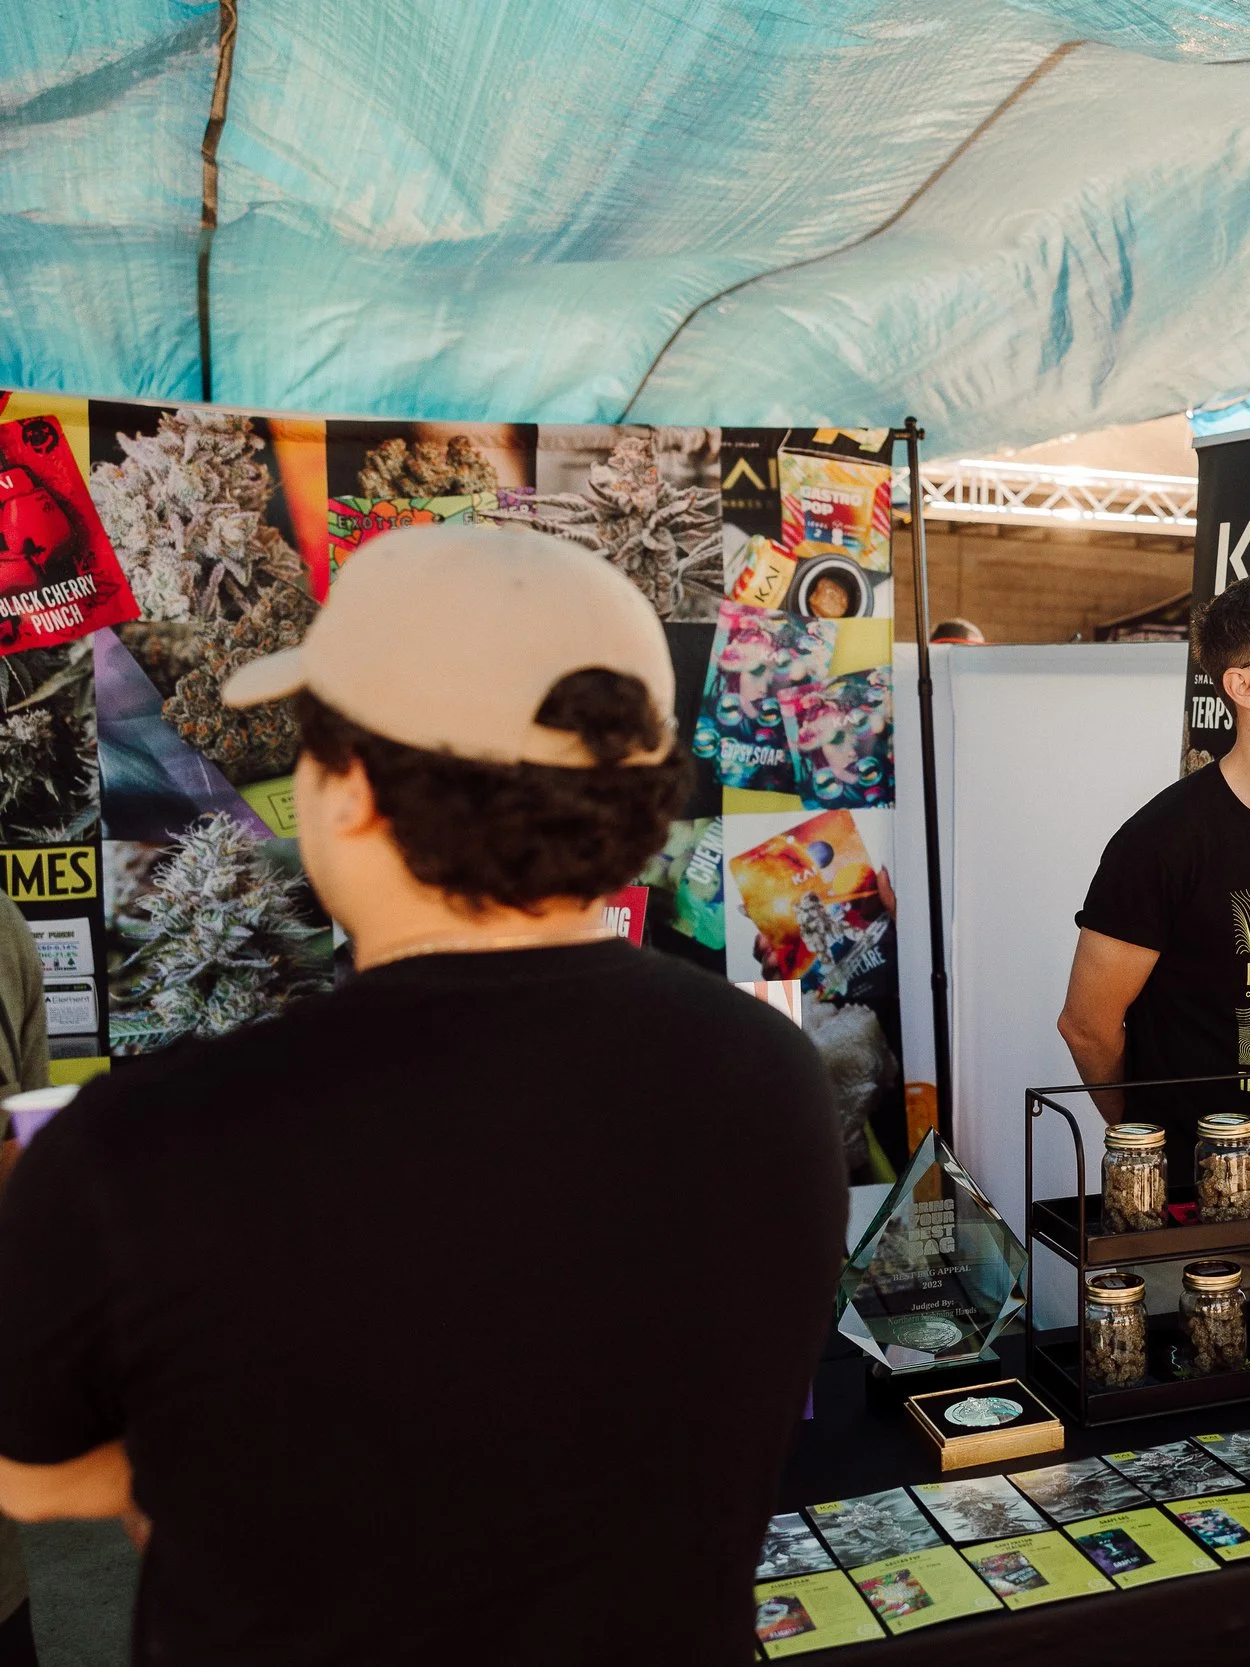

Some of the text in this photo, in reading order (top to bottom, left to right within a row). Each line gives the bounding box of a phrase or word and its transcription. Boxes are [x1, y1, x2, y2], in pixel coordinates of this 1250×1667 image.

[800, 486, 864, 507] GASTRO
[801, 501, 835, 516] POP
[337, 515, 413, 529] EXOTIC
[754, 565, 781, 603] KAI
[0, 574, 97, 618] BLACK CHERRY
[31, 603, 84, 635] PUNCH
[1192, 696, 1234, 730] TERPS
[753, 746, 786, 766] SOAP
[908, 1210, 955, 1228] YOUR
[893, 1271, 915, 1281] BEST
[938, 1264, 972, 1276] APPEAL
[922, 1279, 943, 1290] 2023
[911, 1299, 955, 1312] Judged By:
[955, 1306, 977, 1316] Hands
